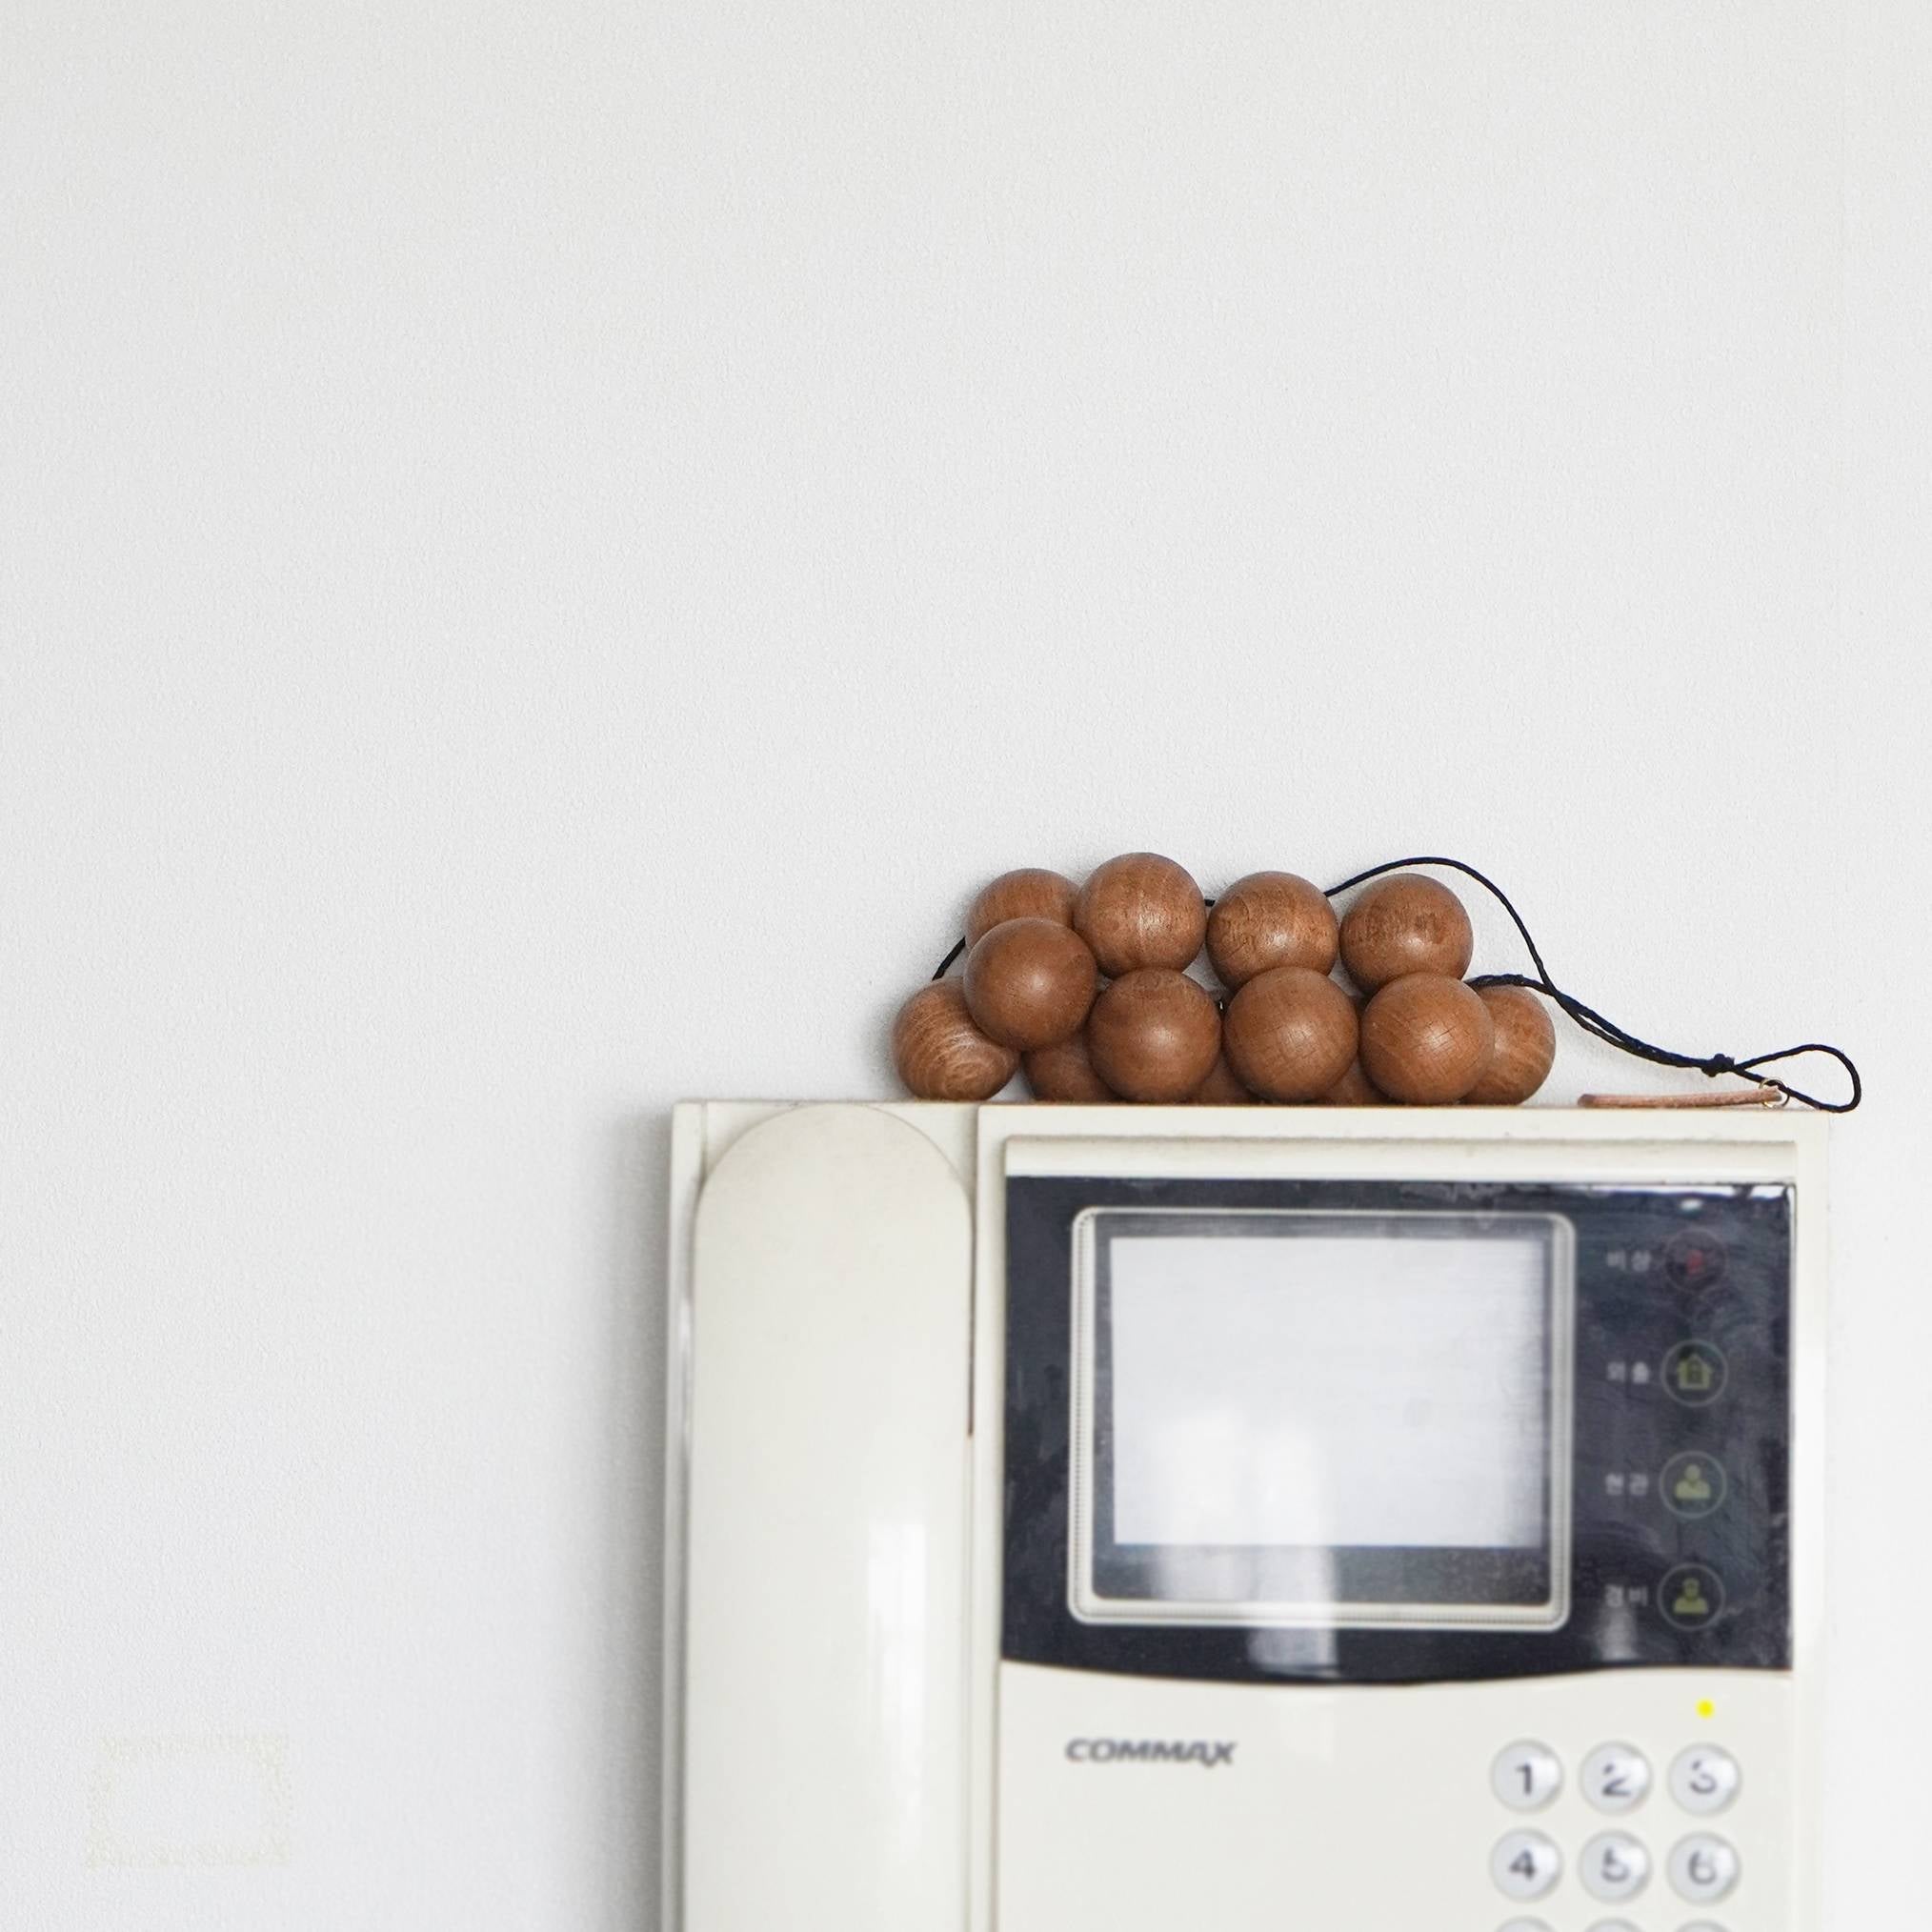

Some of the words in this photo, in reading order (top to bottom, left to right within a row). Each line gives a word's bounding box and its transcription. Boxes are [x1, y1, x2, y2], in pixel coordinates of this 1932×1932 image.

[1065, 1737, 1237, 1768] COMMAX
[1515, 1762, 1533, 1796] 1
[1601, 1762, 1631, 1797] 2
[1689, 1760, 1718, 1795] 3
[1508, 1848, 1538, 1881] 4
[1600, 1848, 1631, 1882] 5
[1687, 1850, 1718, 1885] 6
